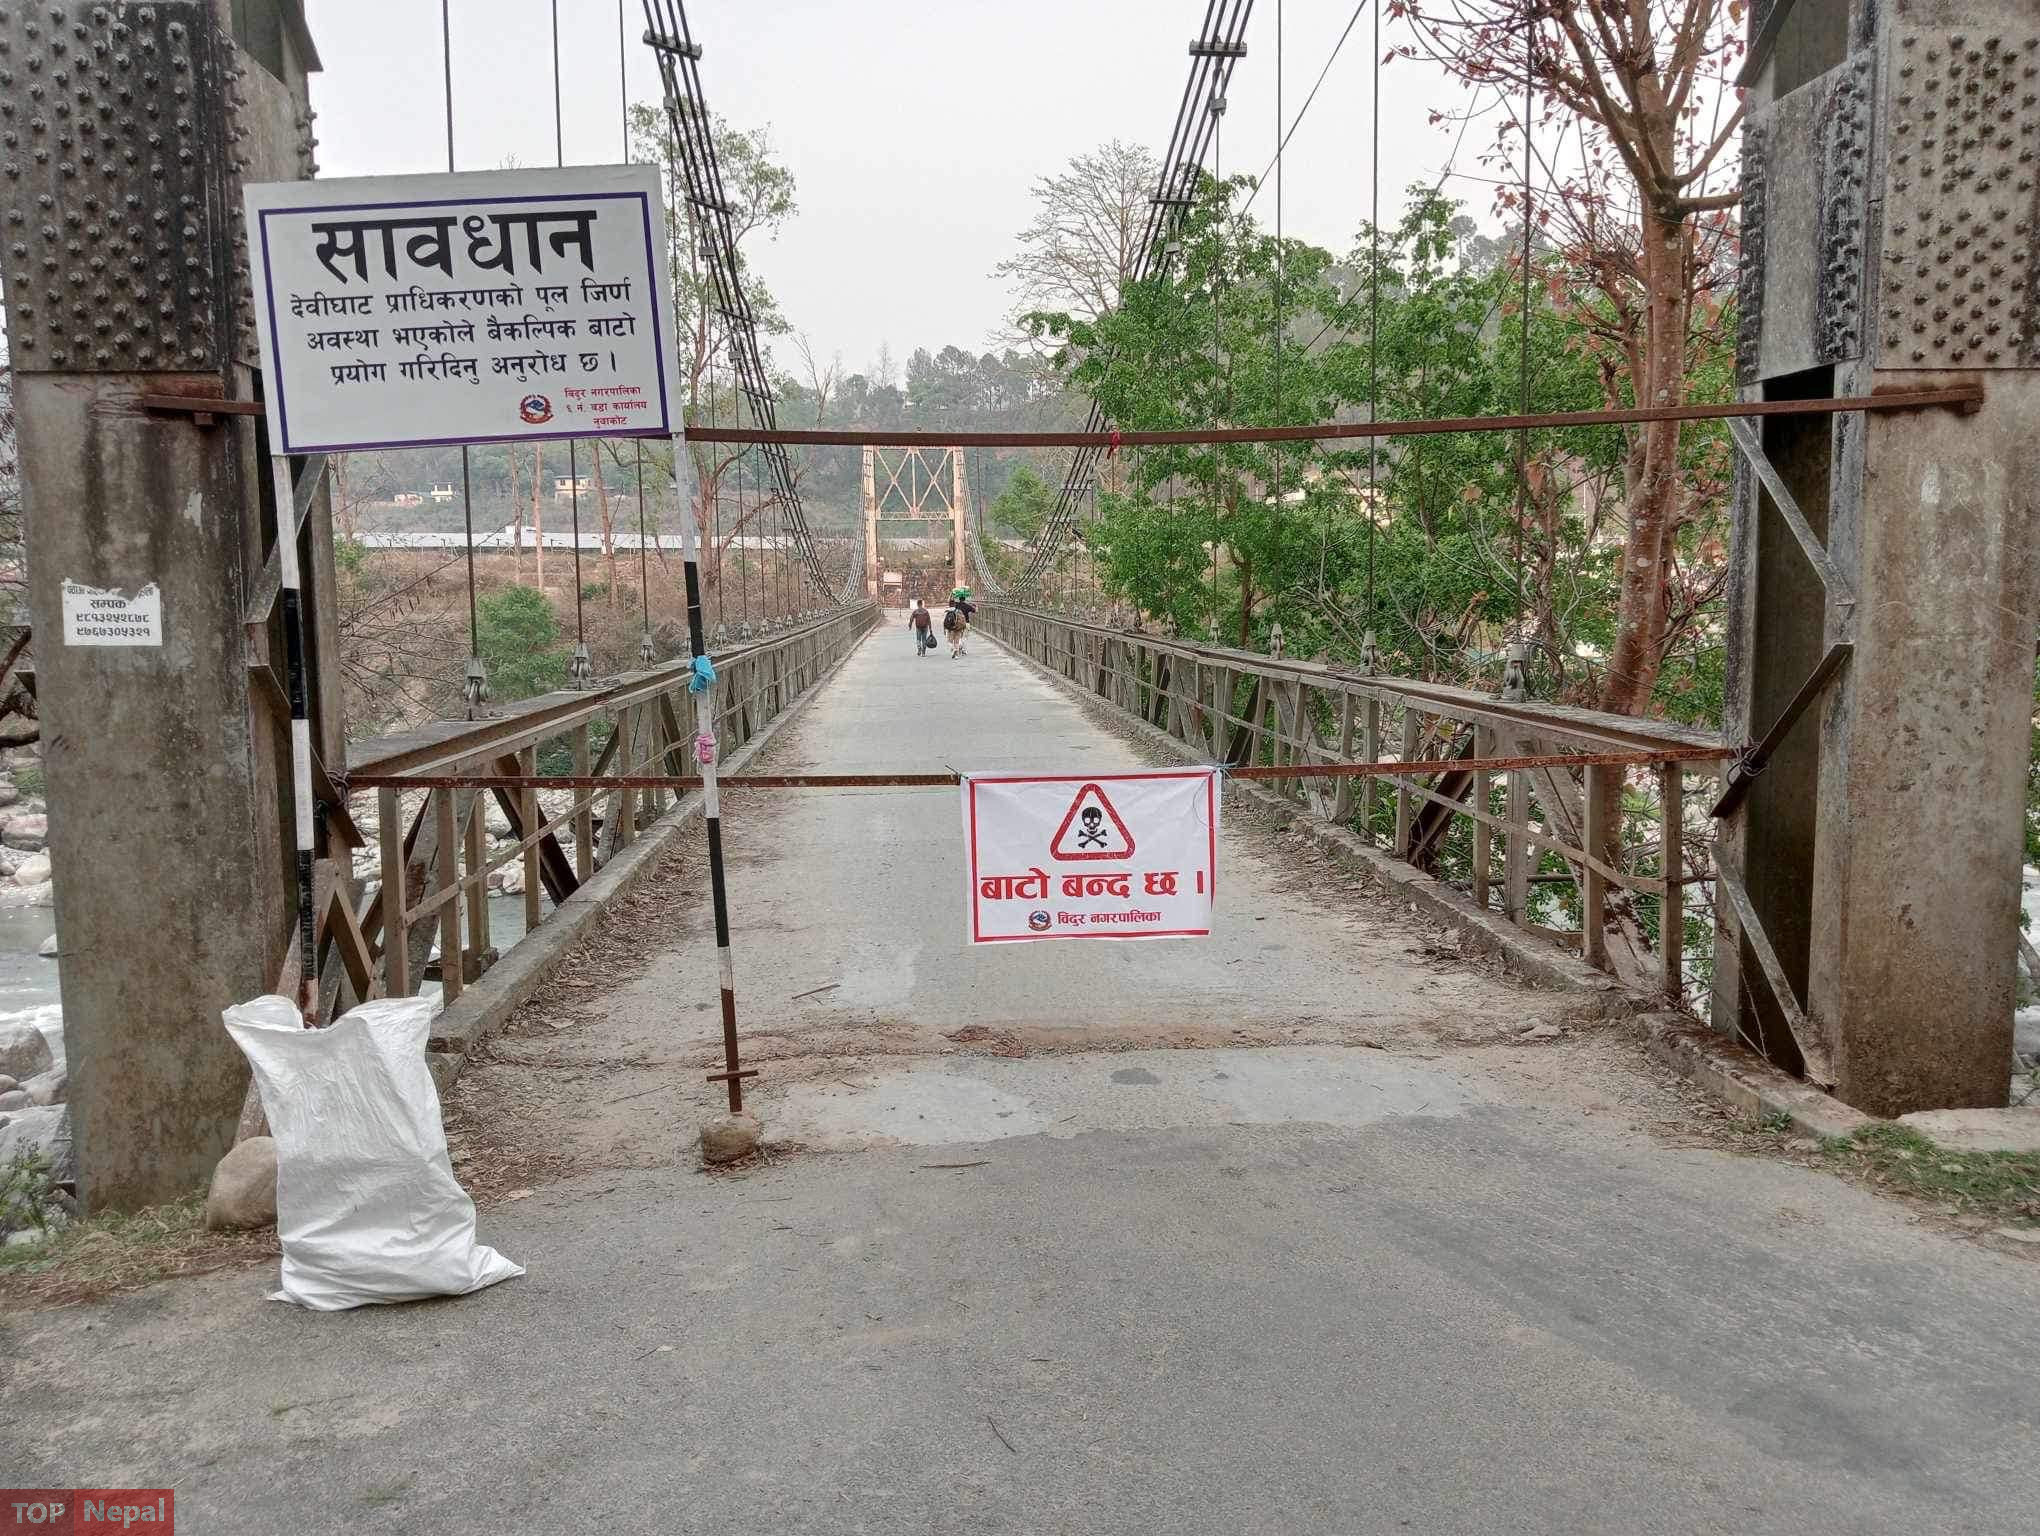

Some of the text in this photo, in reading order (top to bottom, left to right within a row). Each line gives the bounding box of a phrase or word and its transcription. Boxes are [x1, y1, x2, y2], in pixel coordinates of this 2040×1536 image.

[311, 209, 597, 283] सावधान
[290, 291, 373, 318] देवीघाट
[385, 283, 523, 313] प्राधिकरणको
[581, 277, 631, 303] जिर्ण
[307, 329, 379, 350] अवस्था
[393, 319, 475, 350] भएकोले
[588, 312, 636, 337] बाटो
[331, 359, 387, 385] प्रयोग
[399, 353, 480, 385] गरिदिनु
[492, 350, 567, 382] अनुरोध
[579, 352, 599, 372] छ
[591, 385, 641, 397] नगरपालिका
[980, 867, 1050, 899] बाटो
[1062, 872, 1133, 898] बन्द
[1143, 871, 1179, 896] छ
[1090, 909, 1162, 924] नगरपालिका
